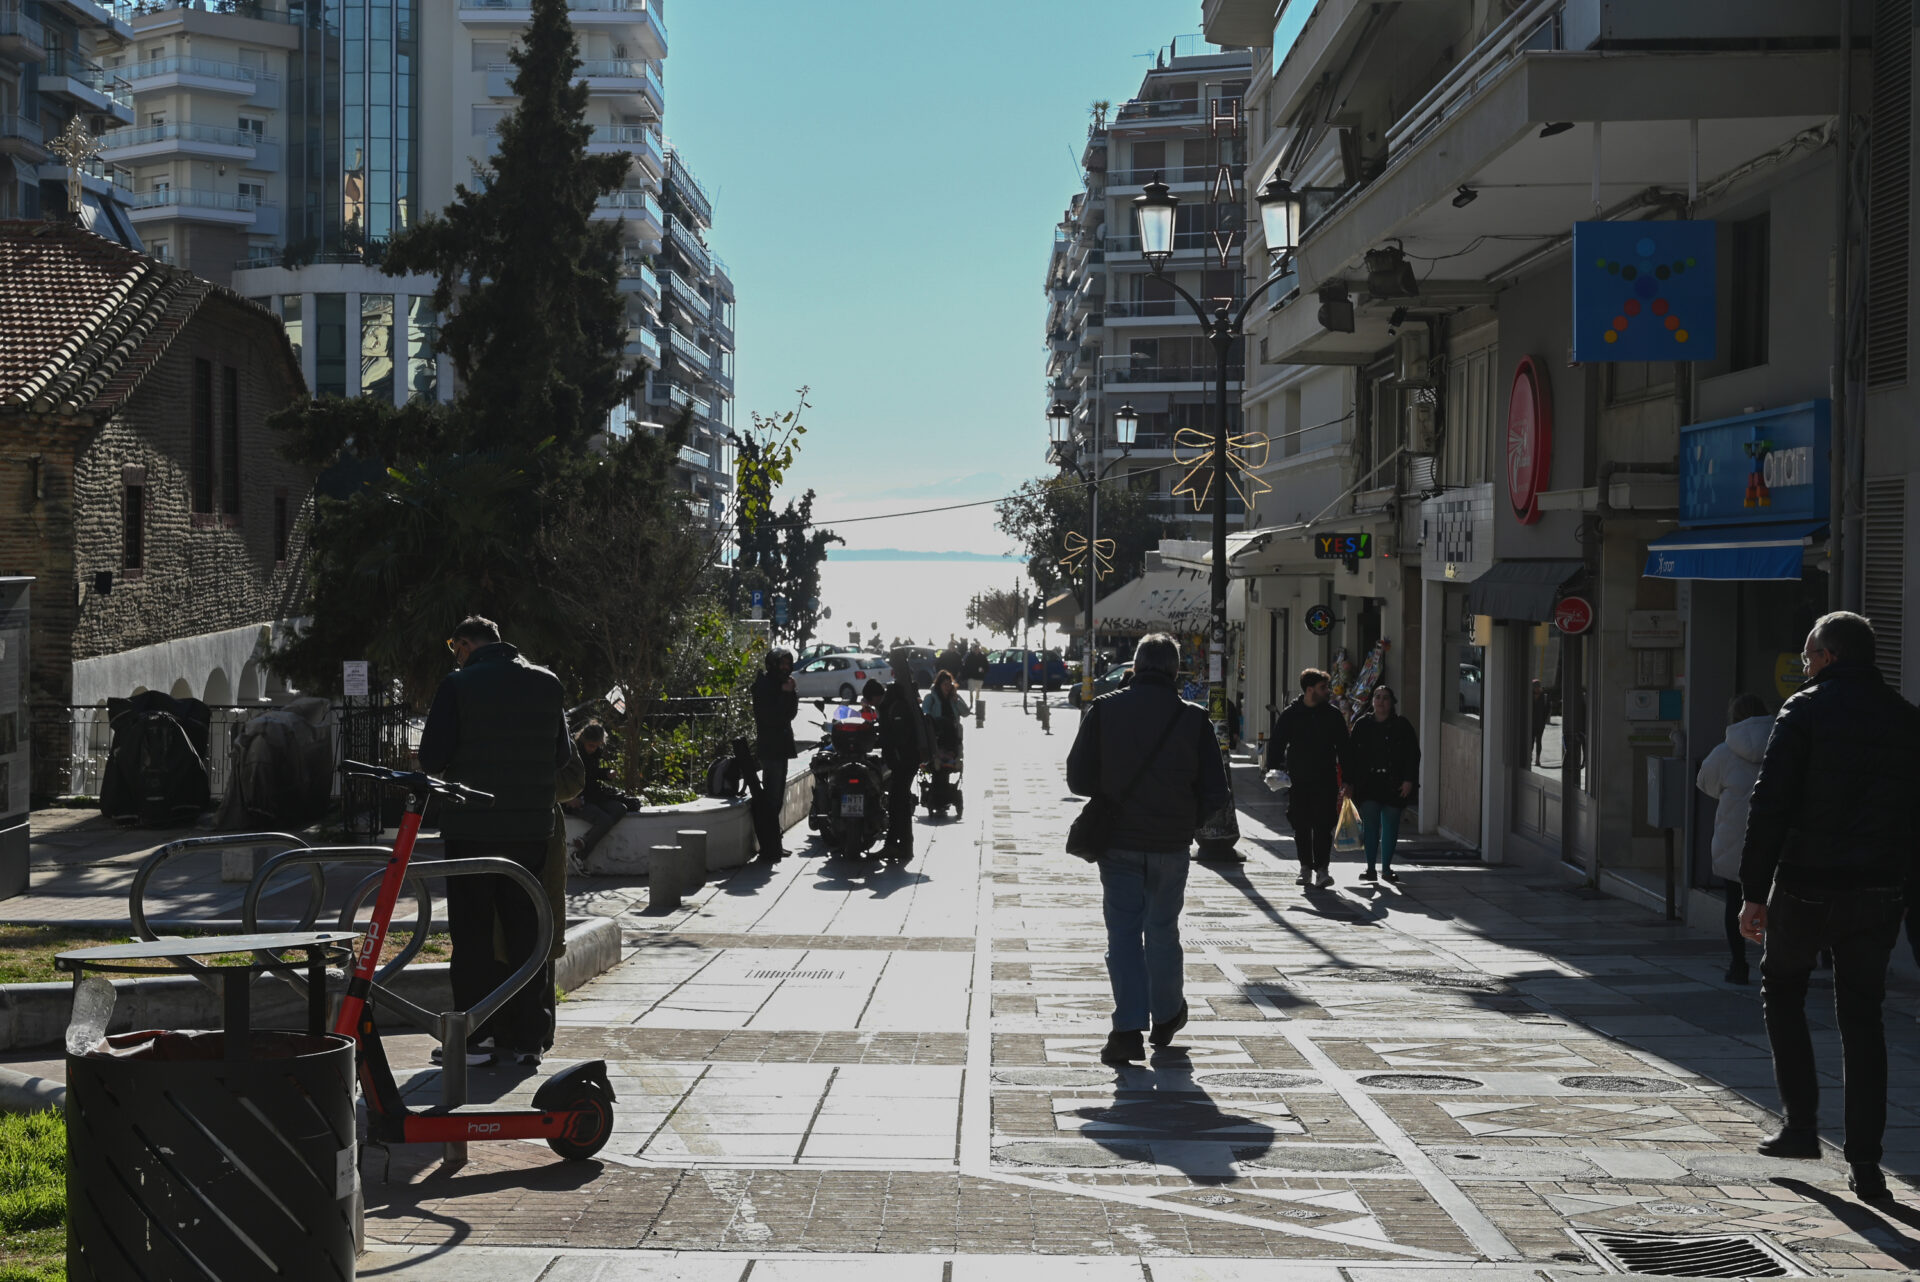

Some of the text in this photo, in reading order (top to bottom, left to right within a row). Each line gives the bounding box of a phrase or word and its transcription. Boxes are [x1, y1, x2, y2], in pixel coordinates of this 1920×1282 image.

[753, 592, 761, 604] P
[356, 921, 380, 971] hop
[467, 1121, 501, 1135] hop
